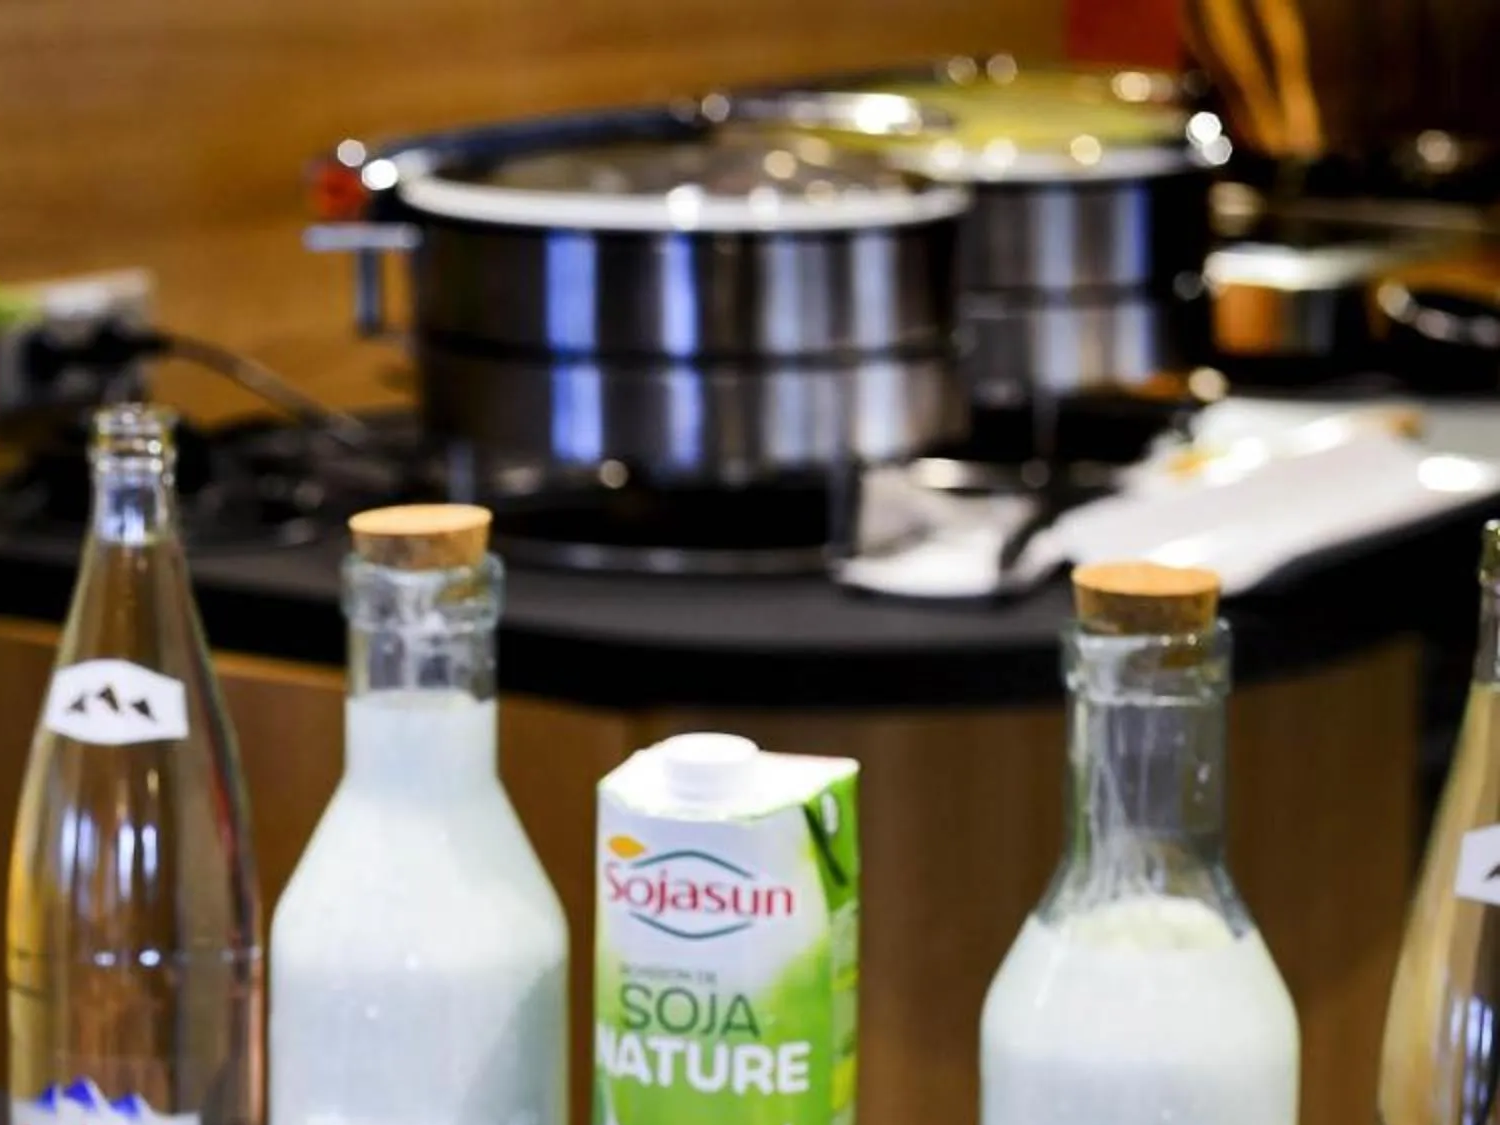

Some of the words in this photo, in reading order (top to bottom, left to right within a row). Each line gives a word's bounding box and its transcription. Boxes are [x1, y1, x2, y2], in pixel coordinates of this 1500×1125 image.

[605, 862, 794, 917] Sojasun
[619, 982, 761, 1039] SOJA
[596, 1022, 810, 1095] NATURE
